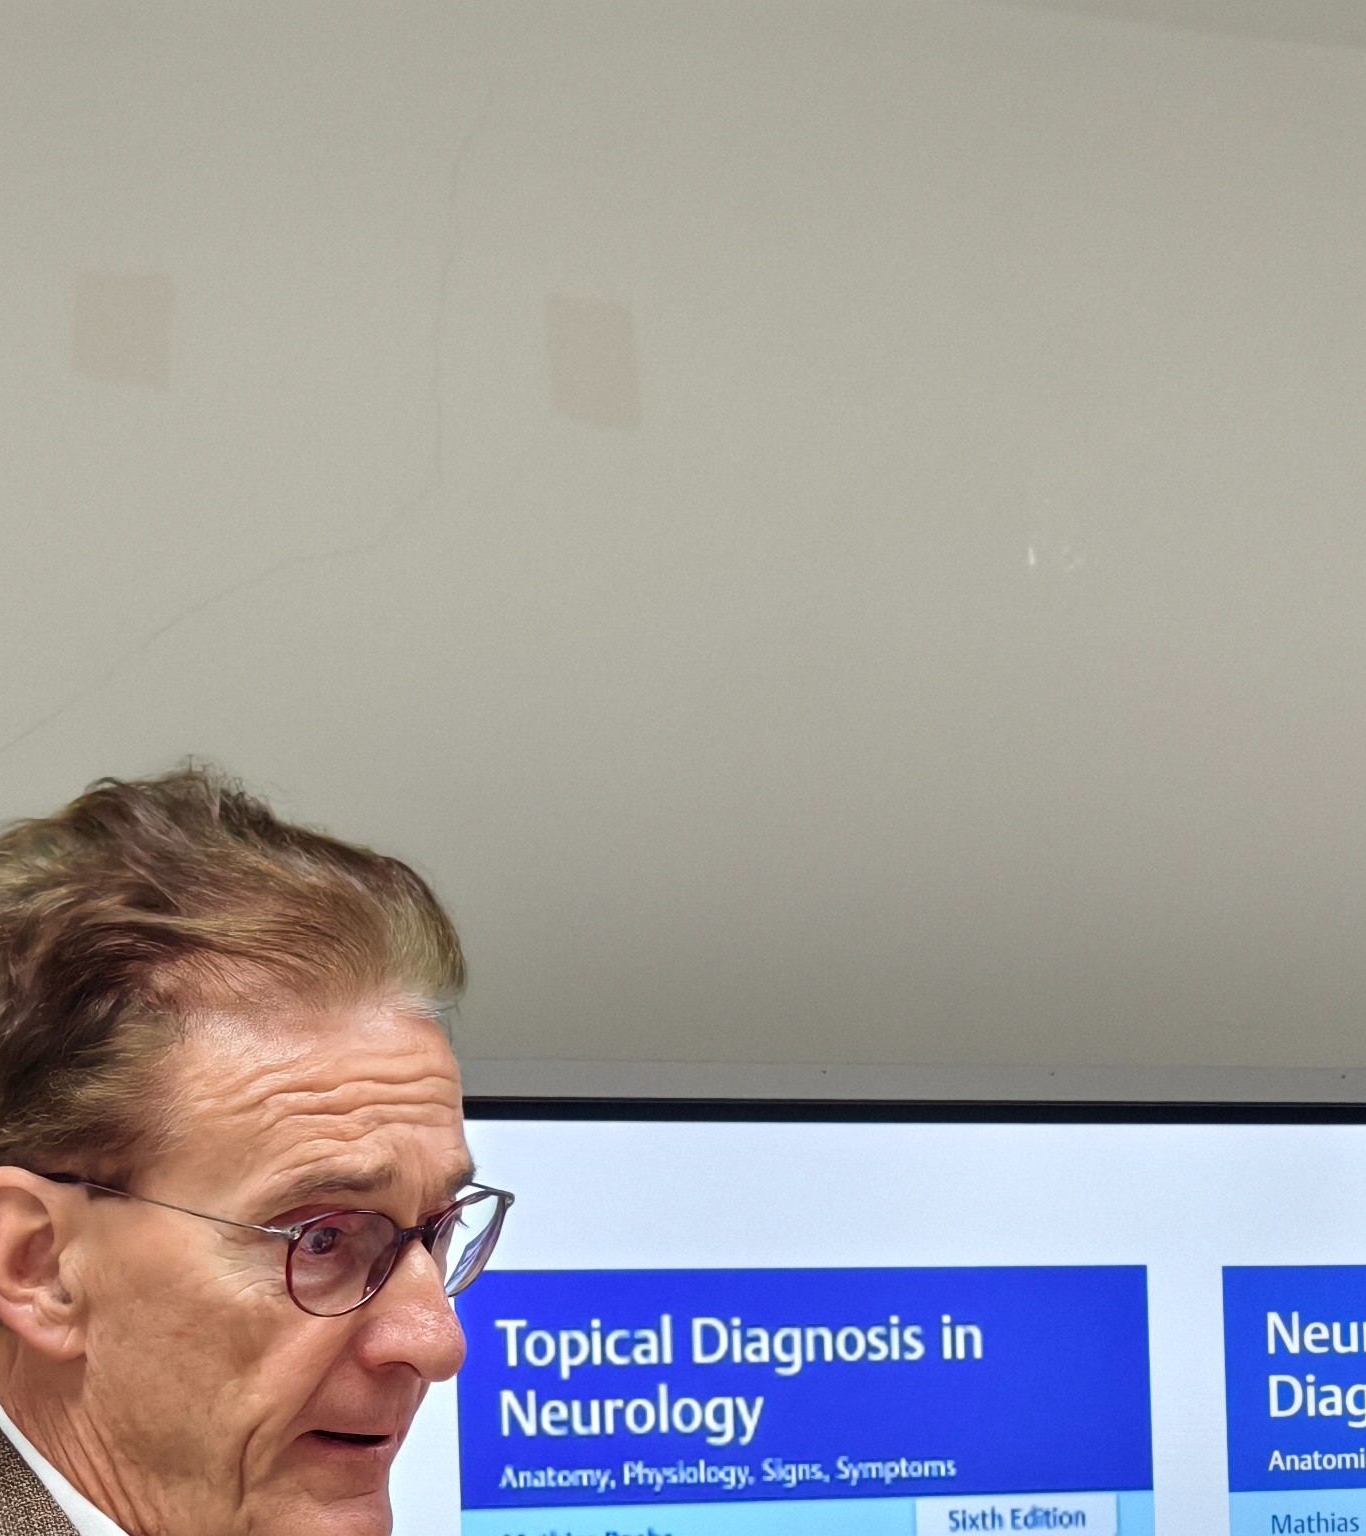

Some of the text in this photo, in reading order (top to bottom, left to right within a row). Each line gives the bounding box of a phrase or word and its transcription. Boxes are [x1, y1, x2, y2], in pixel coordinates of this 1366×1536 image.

[496, 1313, 984, 1378] Topical Diagnosis in
[498, 1384, 764, 1445] Neurology
[498, 1455, 957, 1491] Anatomy, Physiology, Signs, Symptoms
[948, 1504, 1087, 1531] Sixth Edition
[1270, 1511, 1360, 1535] Mathias
